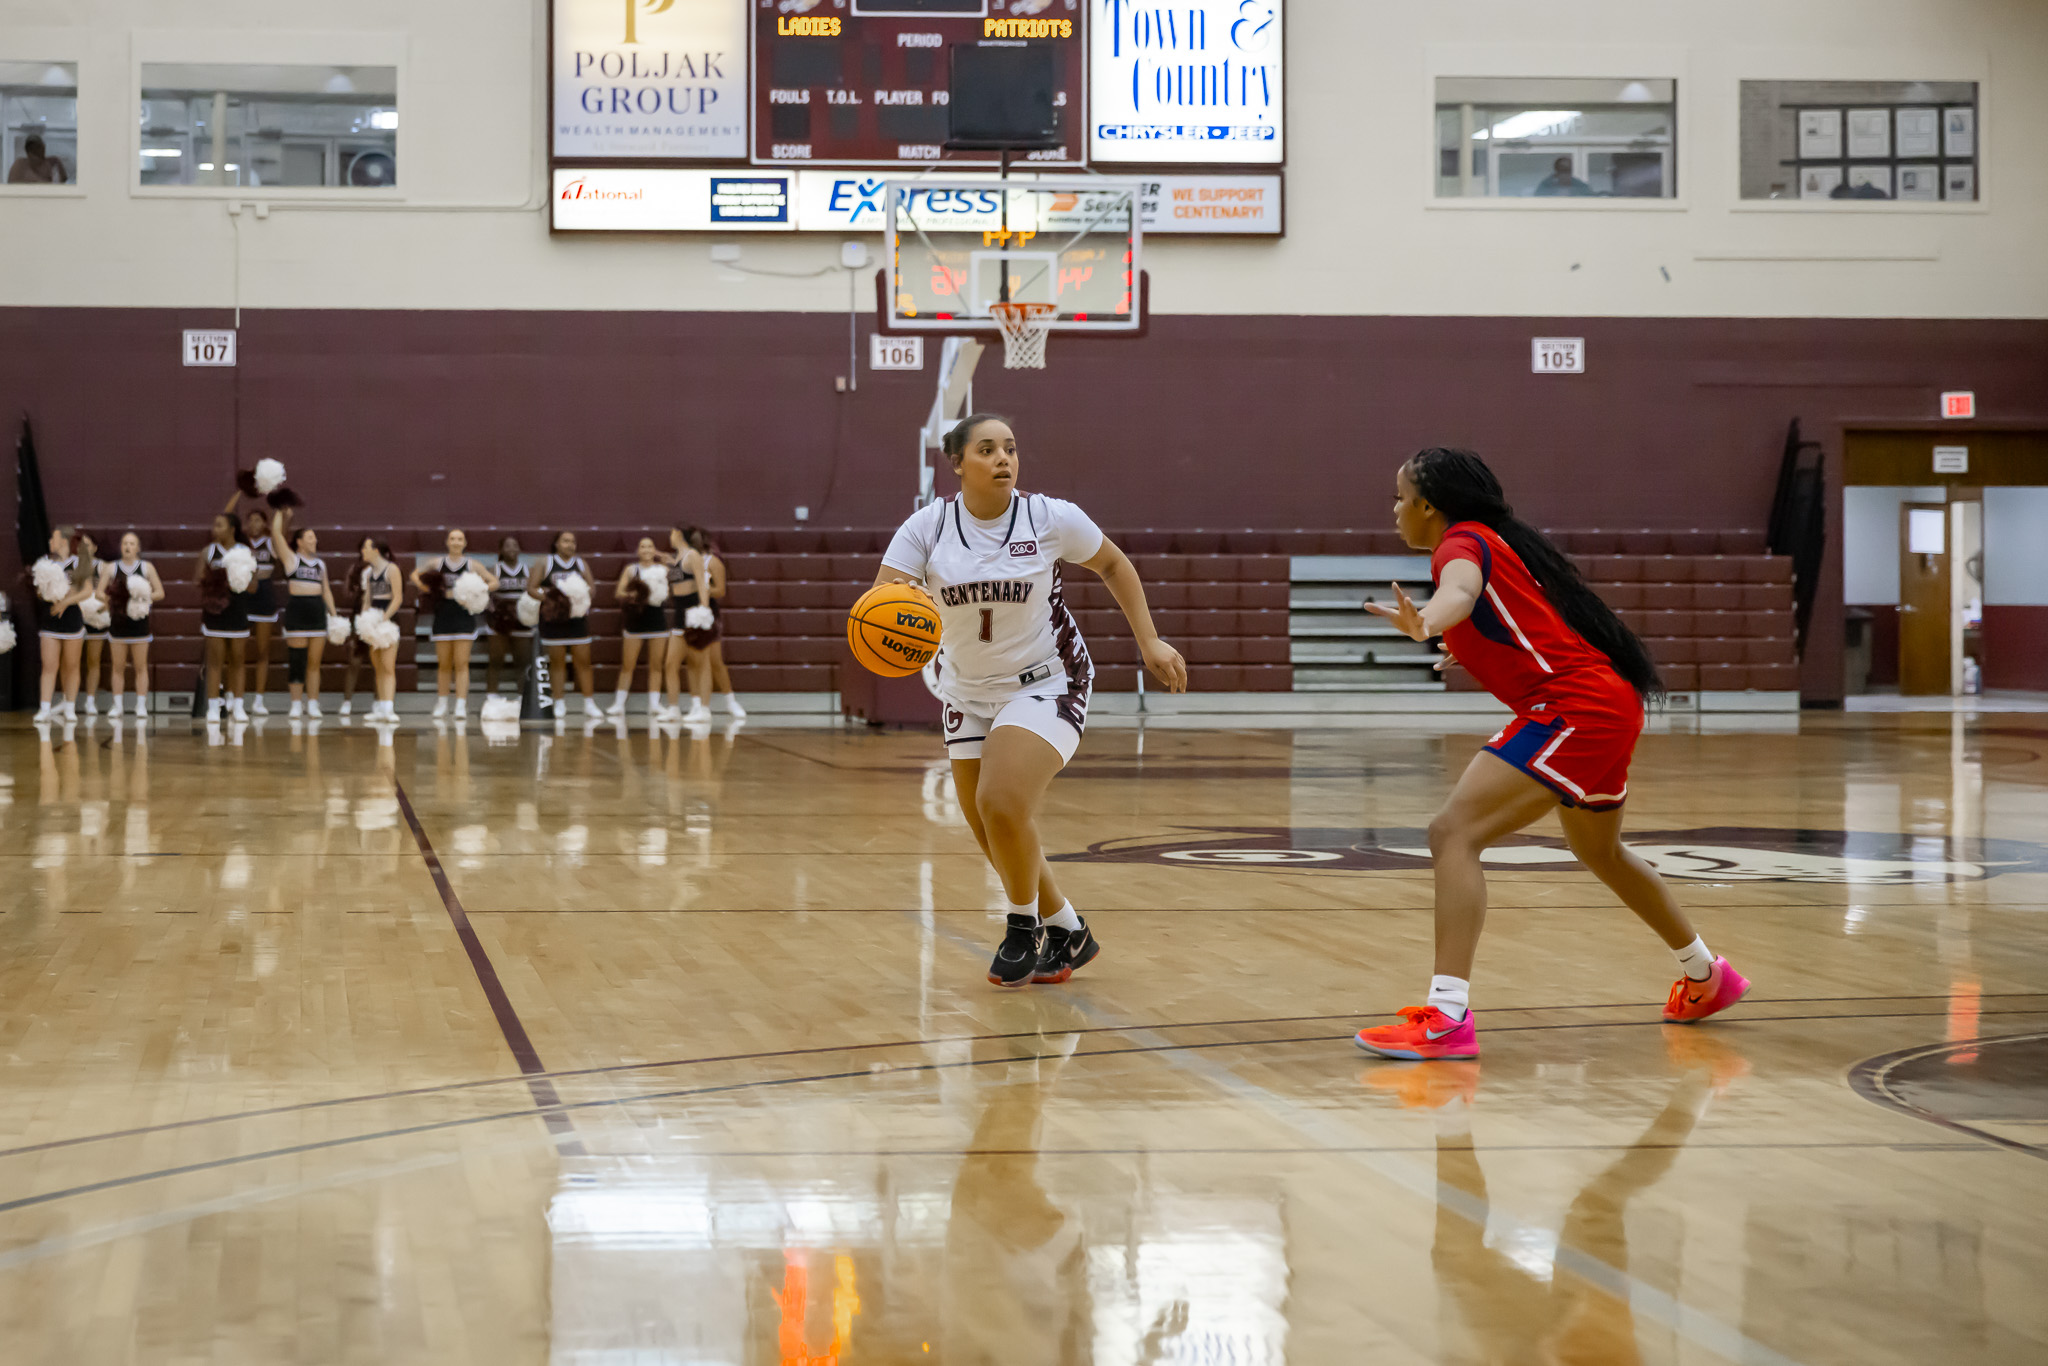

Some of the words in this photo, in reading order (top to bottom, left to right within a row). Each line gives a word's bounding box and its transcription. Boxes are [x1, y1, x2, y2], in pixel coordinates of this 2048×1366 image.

[777, 16, 841, 36] LADIES
[984, 18, 1072, 38] PATRIOTS
[1103, 0, 1205, 57] Town
[1230, 0, 1275, 52] &
[897, 33, 942, 47] PERIOD
[573, 51, 725, 79] POLJAK
[769, 89, 810, 104] FOULS
[826, 89, 862, 104] T.O.L.
[1132, 57, 1276, 120] Country
[580, 86, 719, 114] GROUP
[874, 90, 923, 105] PLAYER
[559, 125, 624, 136] WEALTH
[629, 125, 741, 136] MANAGEMENT
[1100, 126, 1209, 139] CHRYSLER
[1224, 126, 1274, 139] JEEP
[771, 144, 812, 159] SCORE
[898, 145, 940, 160] MATCH
[1172, 188, 1194, 201] WE
[1198, 188, 1264, 201] SUPPORT
[1174, 205, 1263, 219] CENTENARY!
[192, 345, 228, 361] 107
[880, 348, 915, 364] 106
[1541, 352, 1575, 368] 105
[1010, 543, 1035, 555] 200
[940, 580, 1034, 607] CENTENARY
[896, 612, 936, 635] NCAA
[979, 608, 993, 643] 1
[881, 636, 933, 664] Wilson
[535, 656, 554, 709] CCLA
